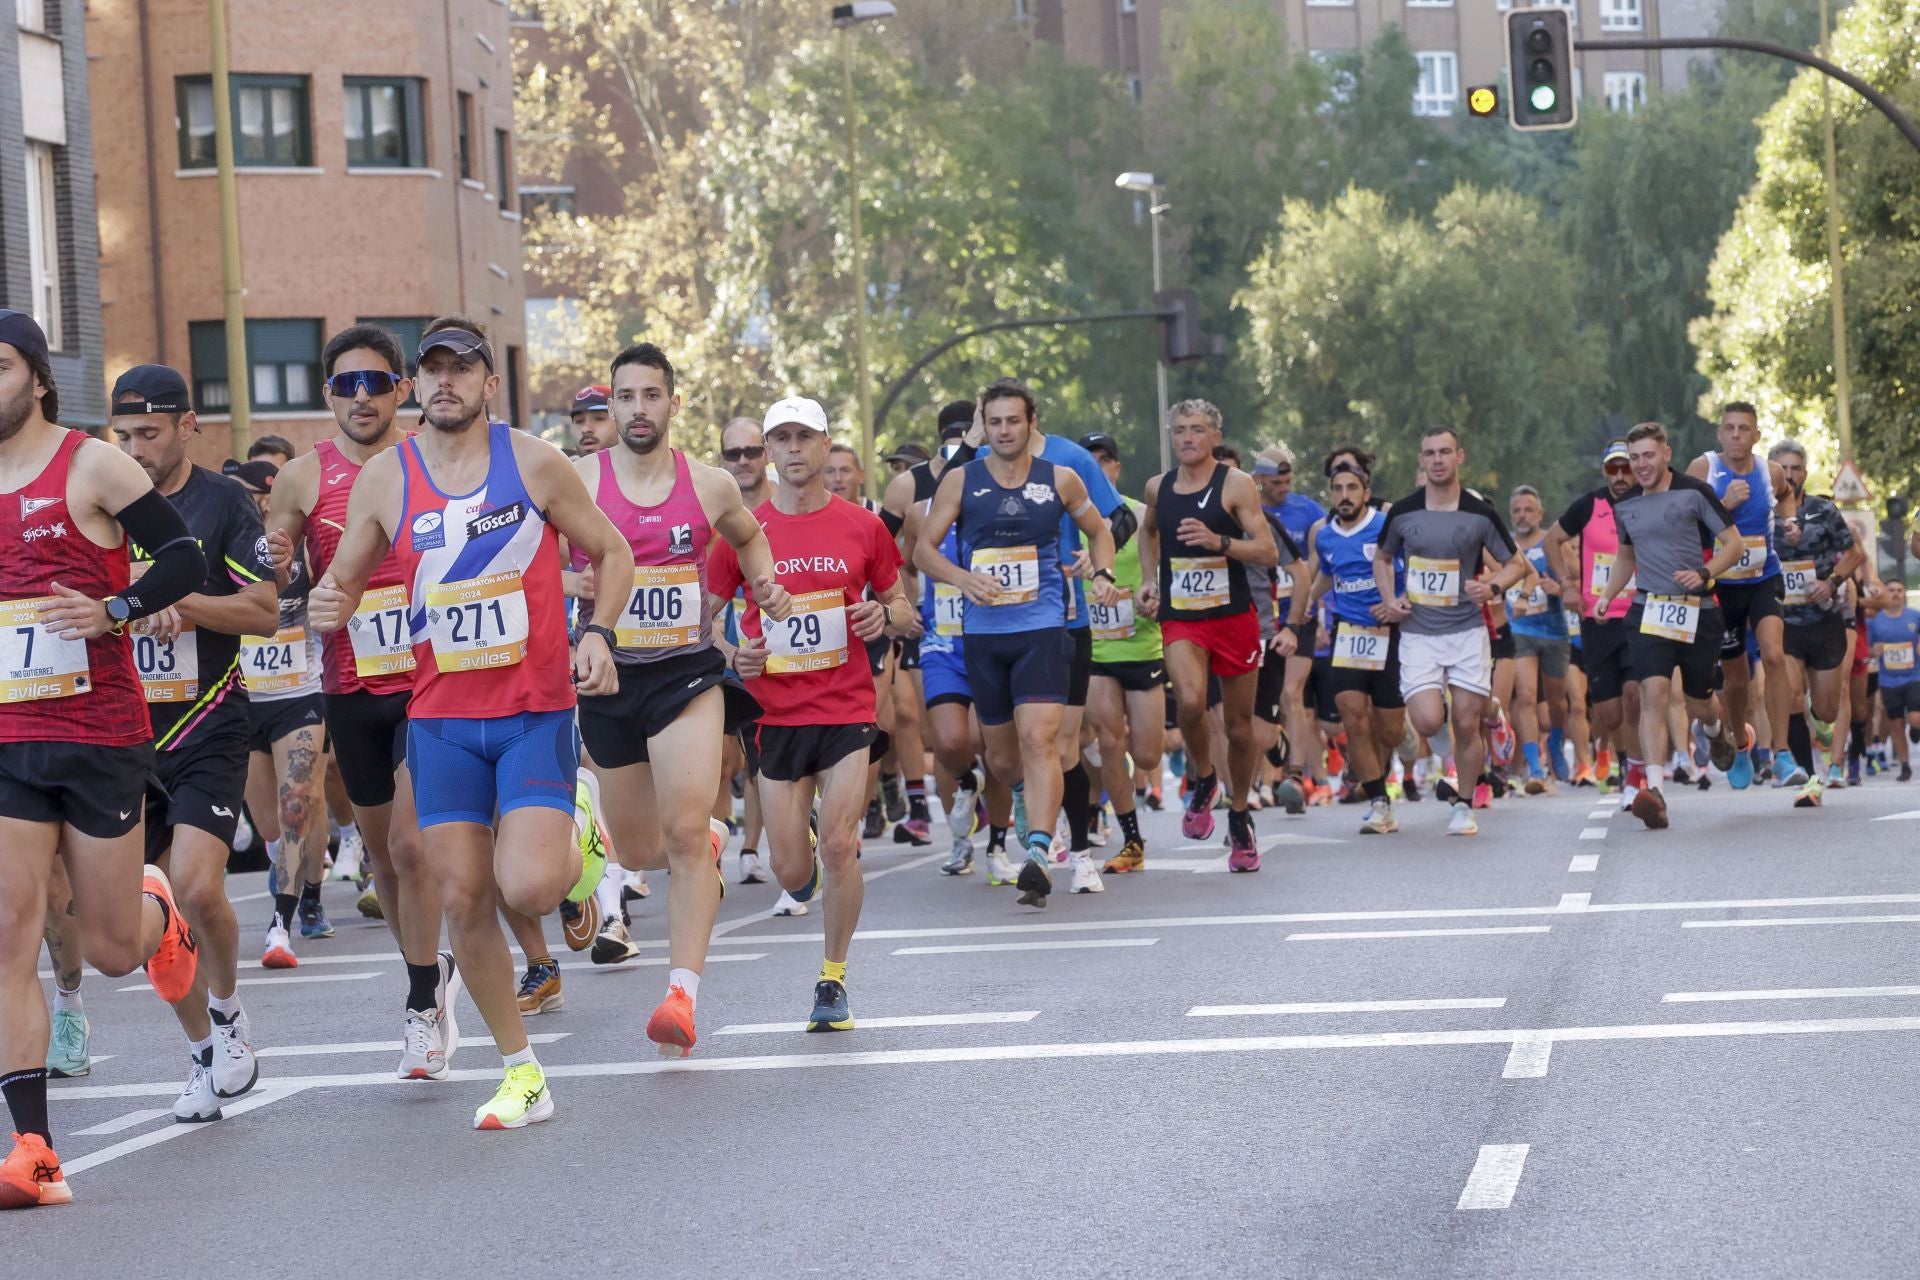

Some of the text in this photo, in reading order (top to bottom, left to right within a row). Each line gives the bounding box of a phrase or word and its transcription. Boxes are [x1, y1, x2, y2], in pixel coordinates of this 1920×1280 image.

[473, 505, 519, 534] Toscaf
[23, 525, 50, 542] gijón
[413, 534, 442, 544] DEPORTE
[774, 556, 848, 575] ORVERA
[461, 576, 495, 589] MARATÓN
[496, 572, 518, 582] AVILÉS
[1181, 571, 1215, 593] 422
[1420, 572, 1447, 591] 127
[383, 597, 402, 606] 2024
[460, 589, 481, 599] 2024
[629, 586, 682, 621] 406
[13, 612, 35, 621] 2024
[446, 600, 506, 642] 271
[1659, 604, 1687, 625] 128
[787, 614, 821, 647] 29
[16, 627, 35, 668] 7
[1349, 636, 1377, 655] 102
[253, 645, 292, 671] 424
